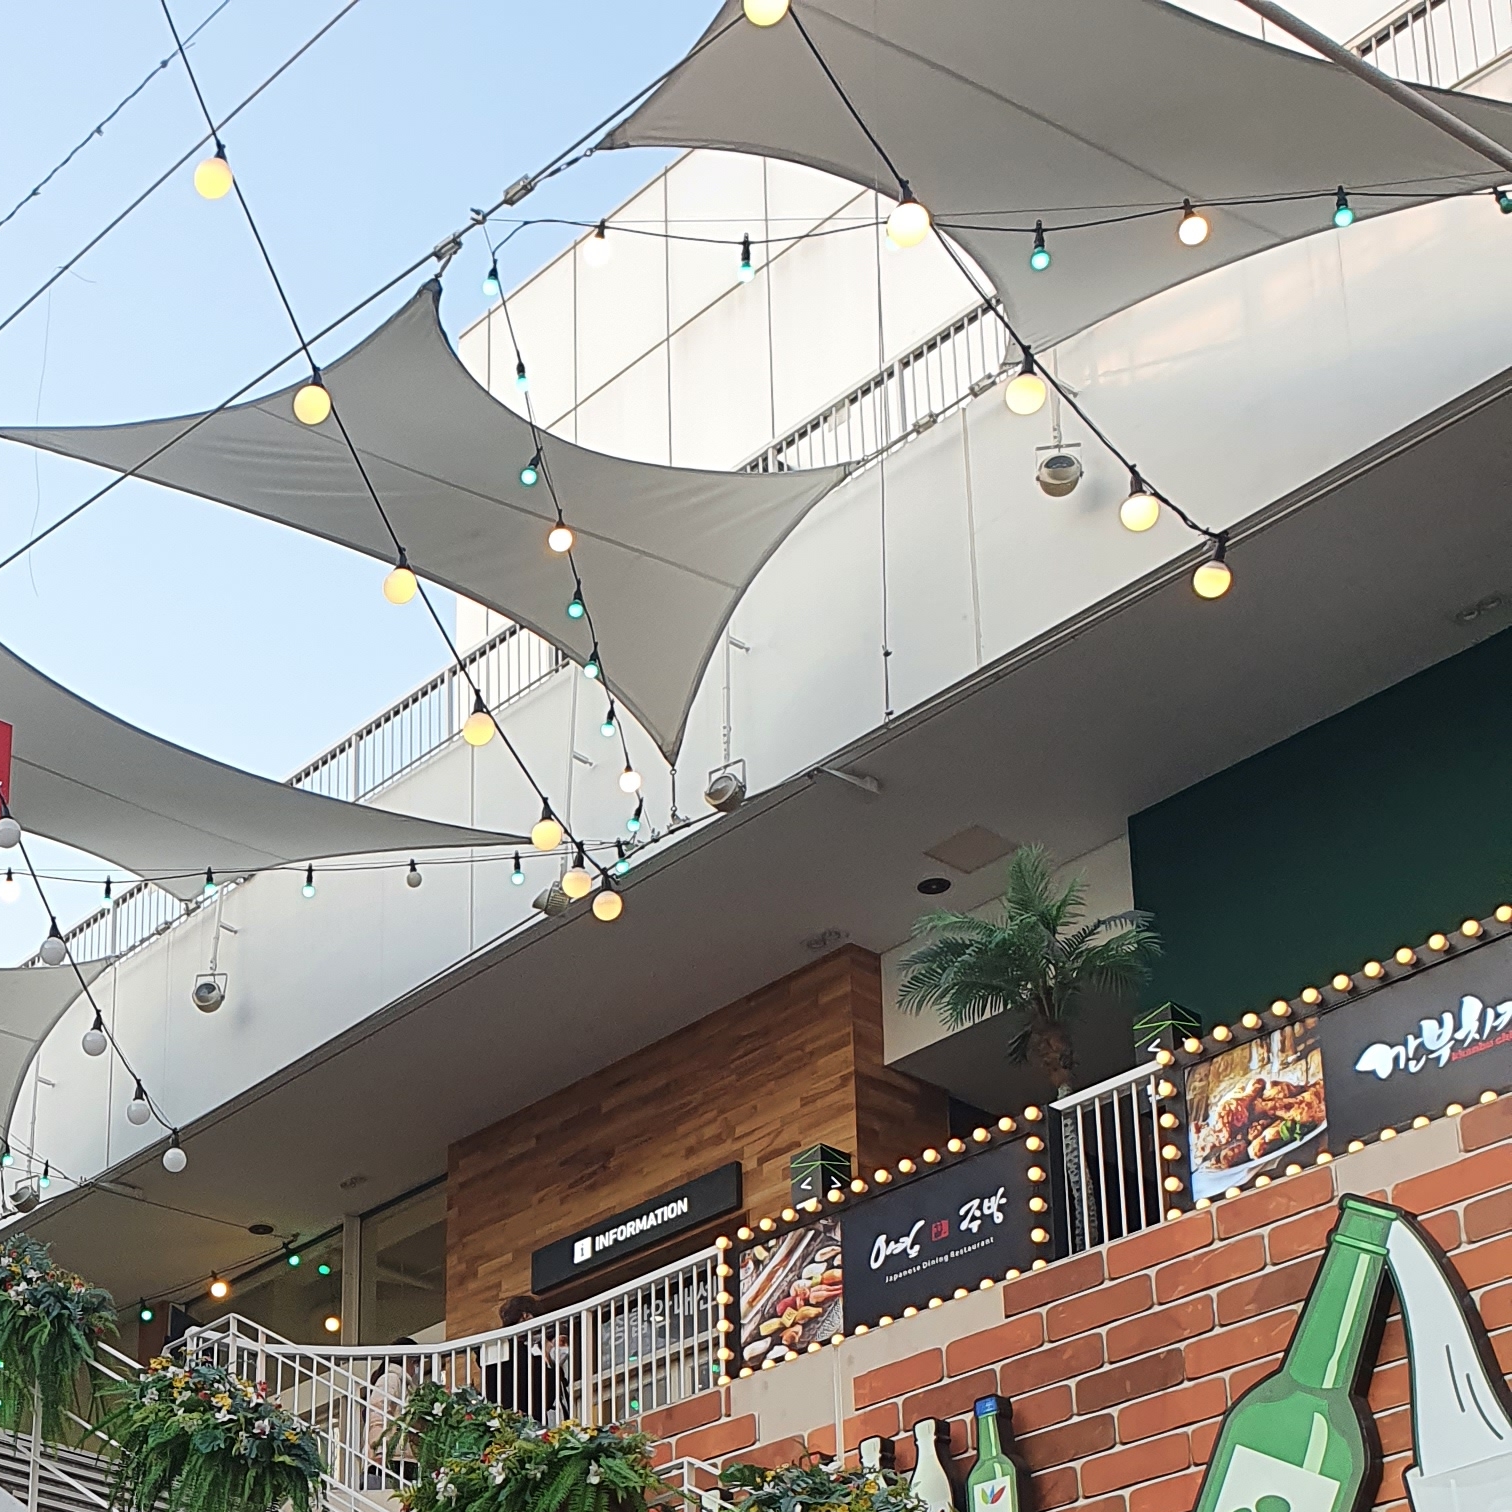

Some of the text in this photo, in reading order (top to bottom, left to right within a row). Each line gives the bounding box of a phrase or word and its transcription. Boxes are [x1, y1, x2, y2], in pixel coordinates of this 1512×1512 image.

[594, 1197, 688, 1252] INFORMATION
[959, 1186, 1007, 1234] 주방
[885, 1236, 995, 1284] Japanese Dining Restaurant
